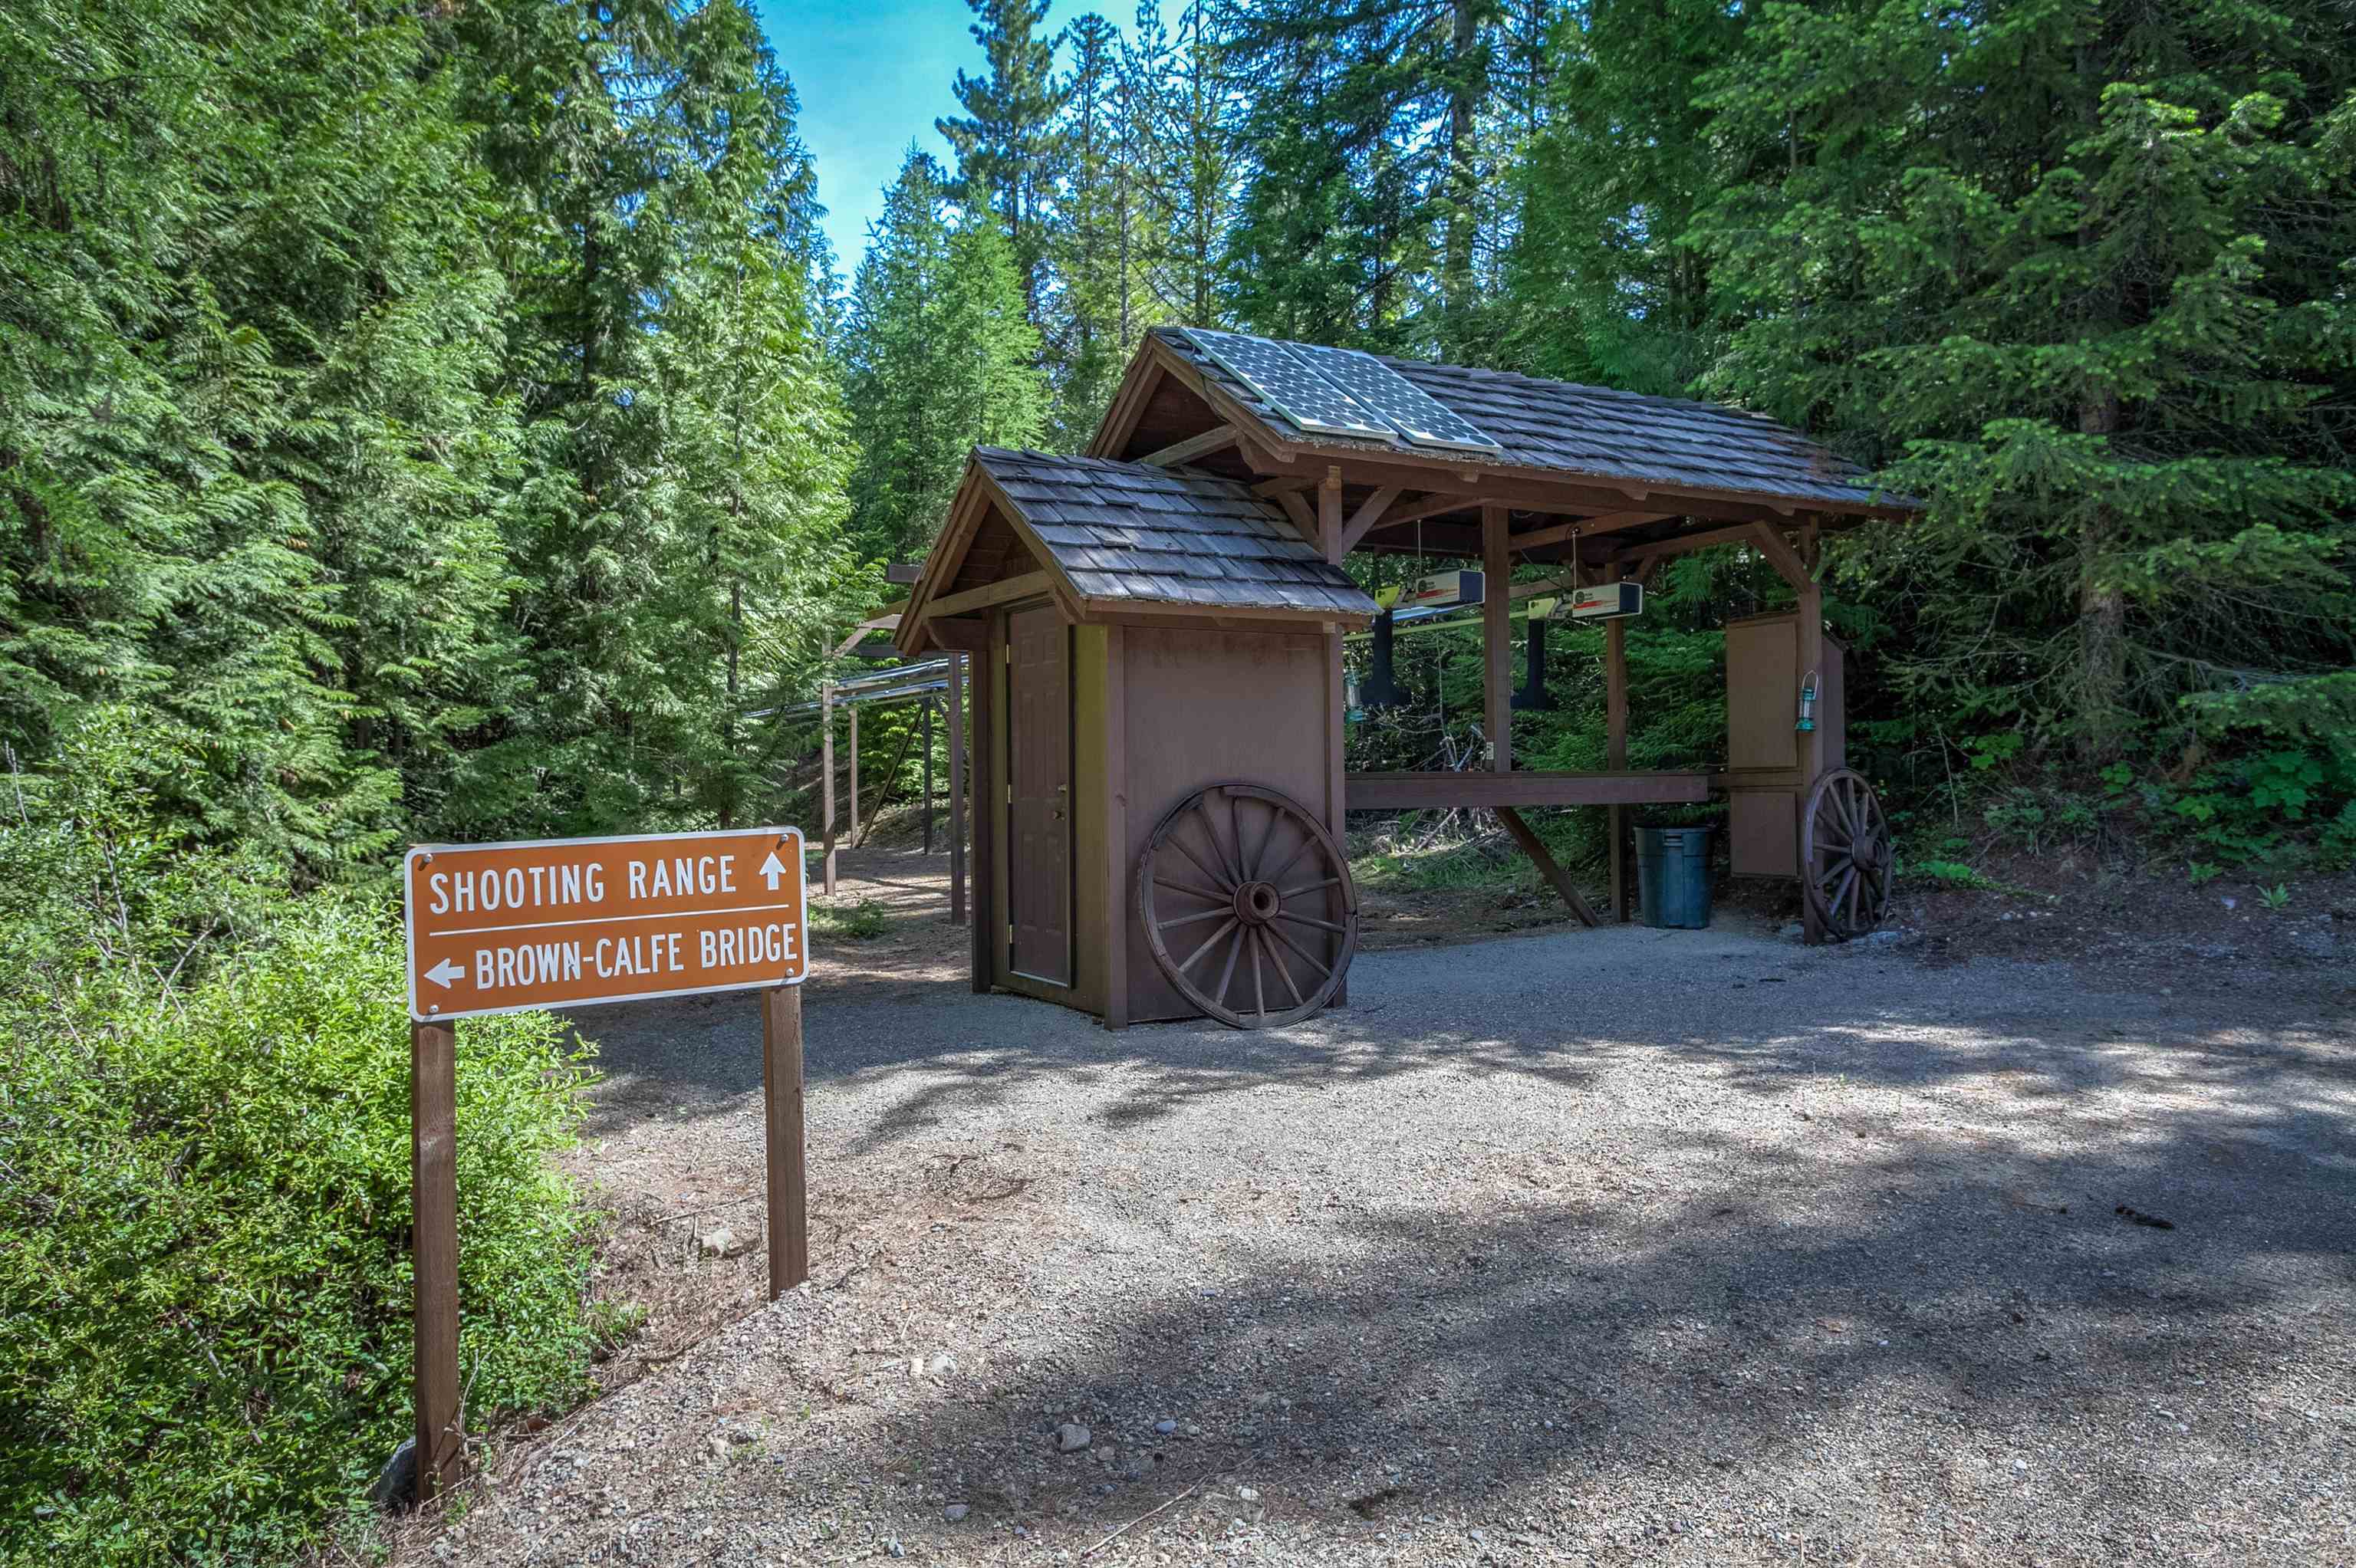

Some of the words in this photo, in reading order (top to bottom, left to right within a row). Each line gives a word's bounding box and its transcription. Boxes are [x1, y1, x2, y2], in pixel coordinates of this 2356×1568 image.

[429, 863, 604, 915] SHOOTING
[628, 855, 737, 899] RANGE
[475, 933, 684, 990] BROWN-CALFE
[699, 922, 798, 968] BRIDGE
